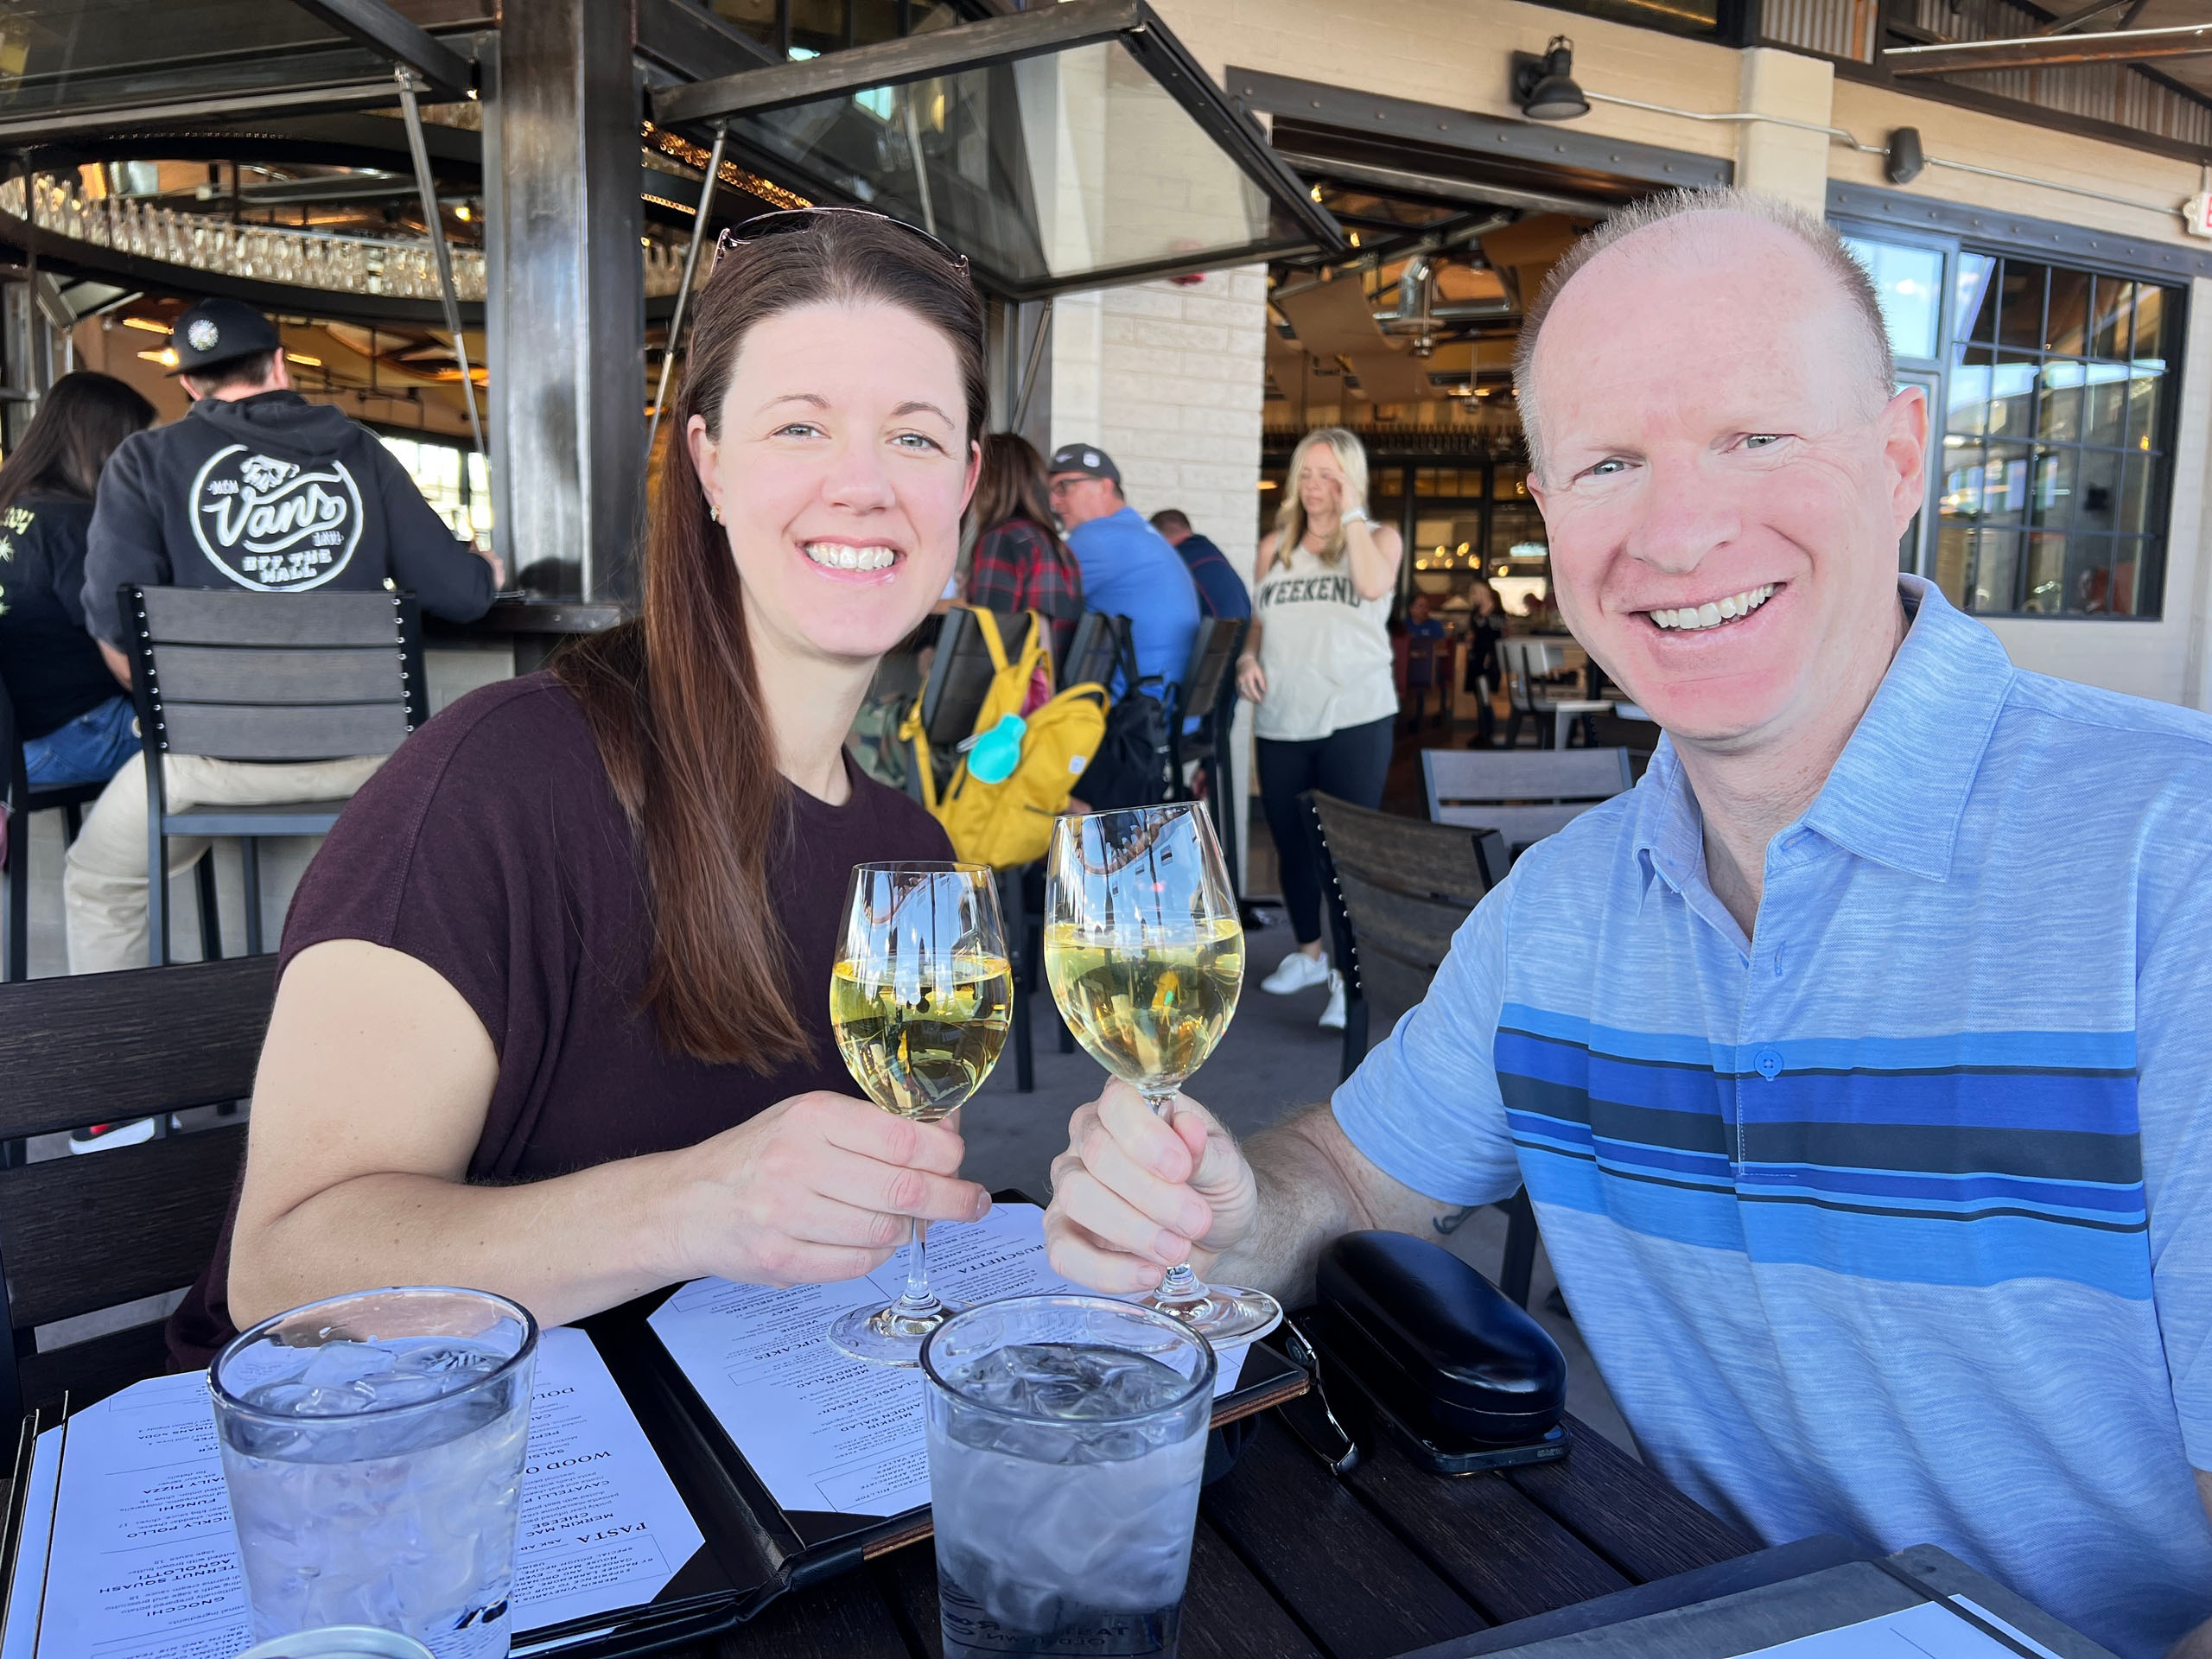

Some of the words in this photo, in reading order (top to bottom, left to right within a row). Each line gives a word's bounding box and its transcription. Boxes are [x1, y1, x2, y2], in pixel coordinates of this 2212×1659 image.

[201, 483, 347, 547] Vans
[930, 1250, 998, 1274] TRADIZIONALE
[958, 1244, 1044, 1274] RUSCHETTA
[725, 1299, 773, 1314] RELLENO
[772, 1306, 799, 1317] MEAT
[779, 1319, 819, 1333] VEGGIE
[797, 1375, 833, 1389] SALAD
[826, 1369, 869, 1385] MERKIN
[871, 1380, 918, 1398] CLASSIC
[840, 1417, 879, 1432] SALAD
[868, 1412, 912, 1430] MERKIN
[546, 1451, 611, 1470] WOOD
[877, 1457, 907, 1470] VALLEY
[909, 1465, 925, 1473] AND
[861, 1471, 907, 1490] APPRECIATE
[143, 1484, 184, 1494] PIZZA
[537, 1480, 610, 1500] CAVATELLI
[855, 1487, 890, 1502] HILLTOP
[159, 1498, 216, 1512] FUNGHI
[569, 1505, 587, 1514] pear
[588, 1499, 613, 1509] prickly
[532, 1512, 588, 1529] CHEESE
[540, 1510, 569, 1521] infused
[561, 1513, 613, 1529] MERKIN
[126, 1525, 178, 1538] POLLO
[525, 1527, 556, 1537] MAC
[576, 1522, 646, 1543] PASTA
[540, 1538, 562, 1548] ASK
[596, 1547, 633, 1558] SPECIAL
[560, 1555, 593, 1567] DOUGH
[586, 1555, 617, 1566] HOUSE
[128, 1567, 155, 1575] butter
[139, 1559, 231, 1580] AGNOLOTTI
[556, 1563, 582, 1573] MADE
[574, 1568, 631, 1585] EXPERIENCE
[581, 1576, 618, 1587] MERKIN
[99, 1578, 167, 1593] SQUASH
[172, 1583, 200, 1592] cream
[144, 1589, 170, 1598] sauce
[523, 1586, 577, 1601] VINEYARDS
[105, 1599, 150, 1611] prosciutto
[120, 1605, 151, 1614] potato
[147, 1596, 225, 1617] GNOCCHI
[153, 1596, 194, 1609] prepared
[168, 1611, 219, 1625] ingredients
